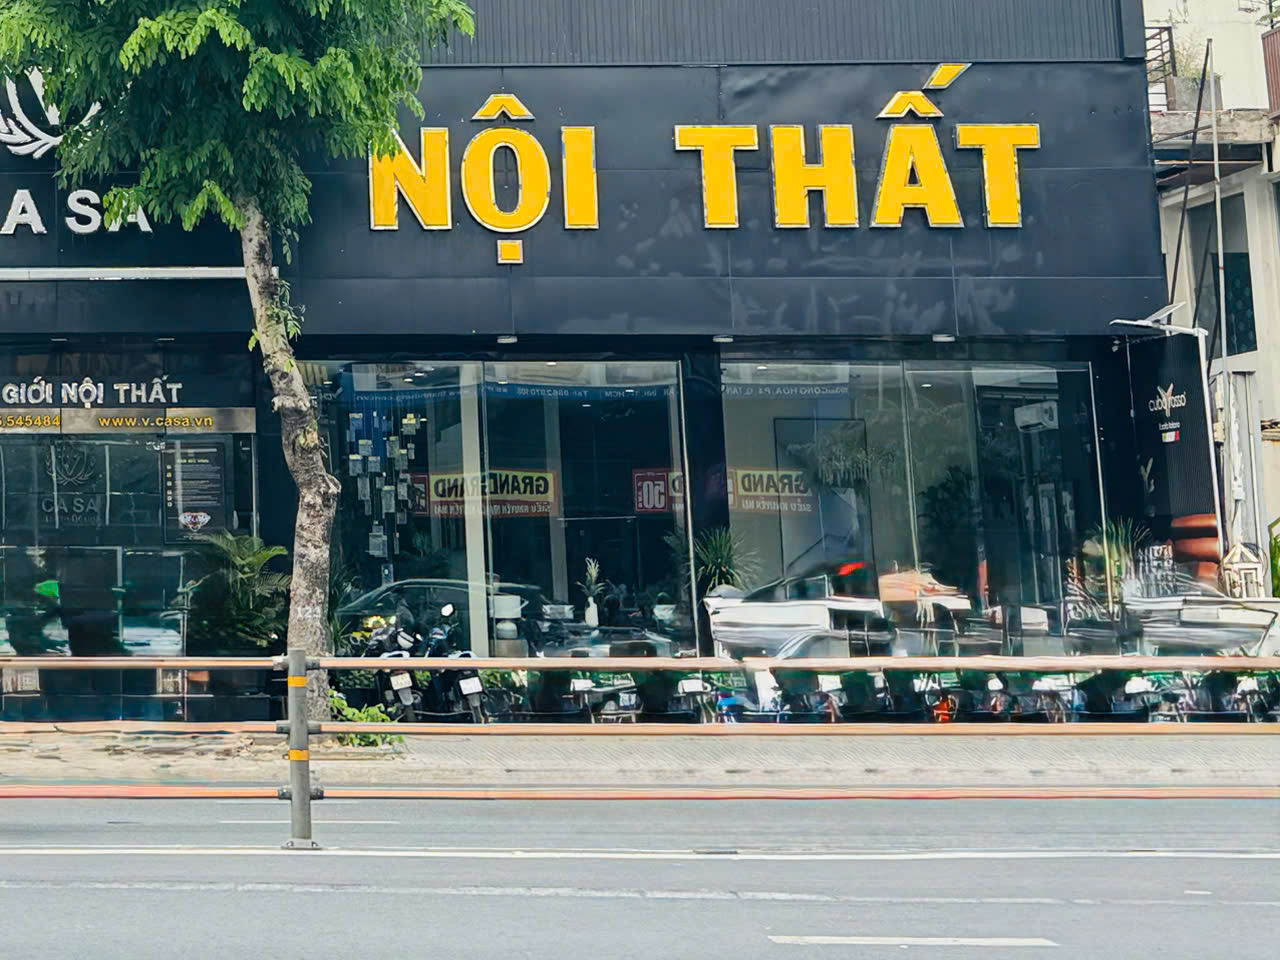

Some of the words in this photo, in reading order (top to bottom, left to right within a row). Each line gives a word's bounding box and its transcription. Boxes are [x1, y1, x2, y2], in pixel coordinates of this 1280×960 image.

[369, 94, 600, 265] NỘI
[674, 63, 1041, 229] THẤT
[1, 375, 53, 405] GIỚI
[61, 376, 104, 409] NỘI
[113, 375, 183, 405] THẤT
